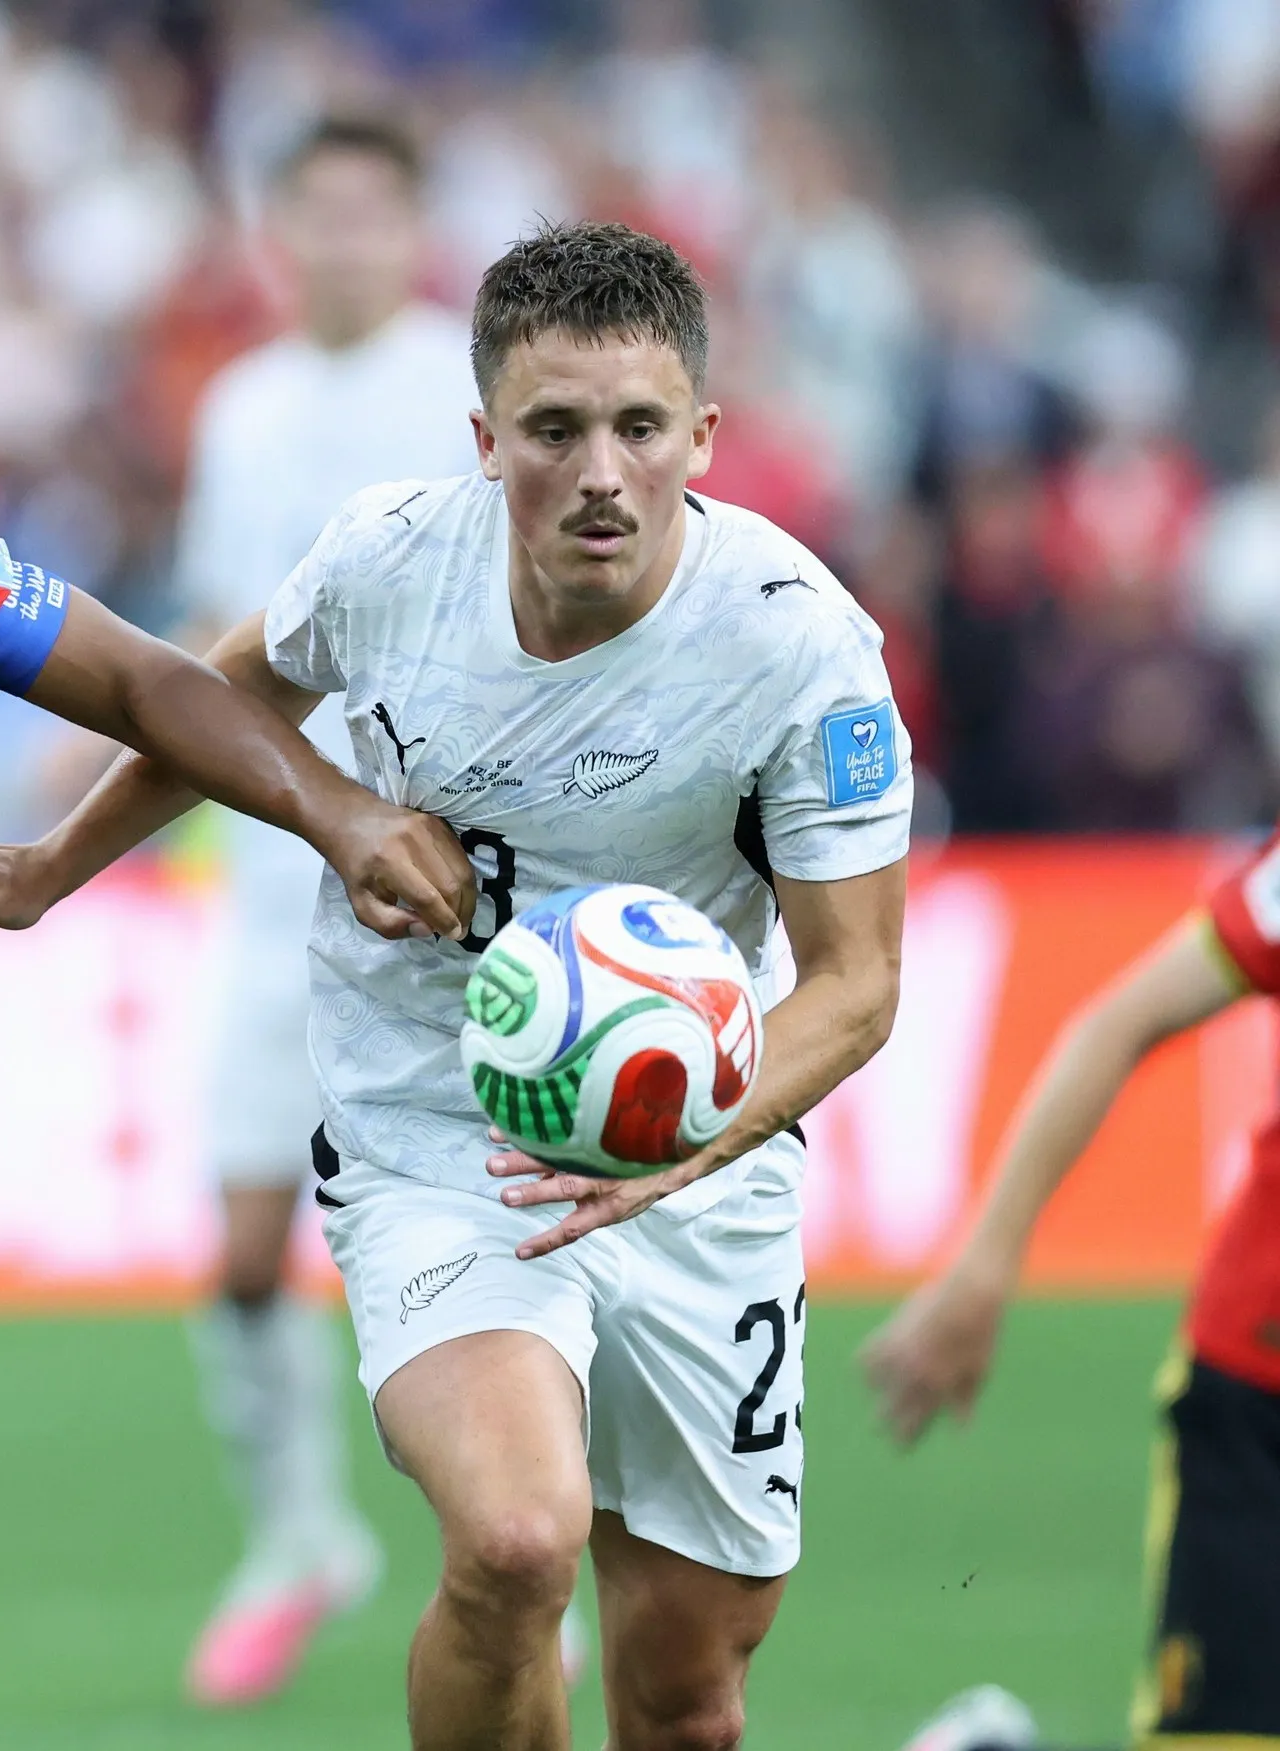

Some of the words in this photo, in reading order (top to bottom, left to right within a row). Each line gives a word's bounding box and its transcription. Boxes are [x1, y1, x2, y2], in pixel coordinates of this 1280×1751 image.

[850, 761, 884, 786] PEACE
[856, 782, 878, 793] FIFA
[442, 827, 516, 953] 3
[732, 1283, 805, 1454] 2
